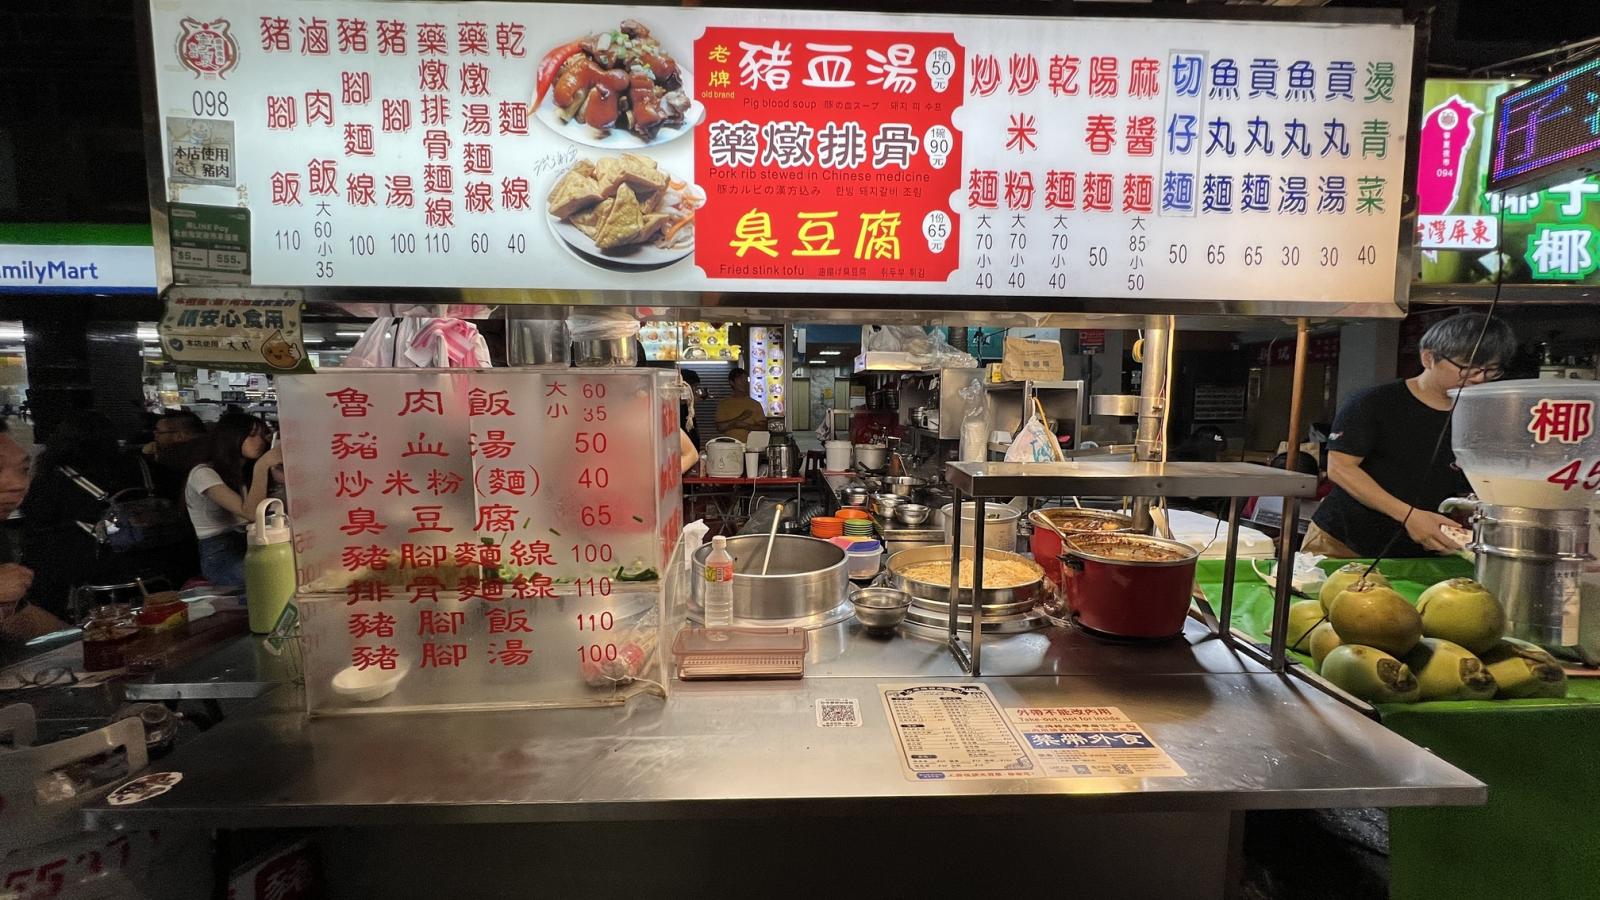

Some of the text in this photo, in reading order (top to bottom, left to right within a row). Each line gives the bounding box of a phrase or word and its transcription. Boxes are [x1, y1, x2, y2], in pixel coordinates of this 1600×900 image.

[708, 44, 732, 88] 老牌
[931, 61, 951, 76] 50
[192, 90, 229, 117] 098
[701, 90, 735, 100] old brand
[743, 98, 817, 110] Pig blood soup
[260, 16, 302, 207] 豬腳飯
[299, 16, 339, 197] 滷肉飯
[337, 18, 377, 206] 豬腳麵線
[376, 19, 416, 208] 豬腳湯
[496, 22, 531, 211] 乾麵線
[416, 22, 454, 228] 藥燉排骨麵線
[457, 21, 496, 214] 藥燉湯麵線
[968, 53, 1001, 210] 炒麵
[1004, 53, 1040, 210] 炒米粉
[1045, 54, 1080, 212] 乾麵
[1082, 56, 1119, 213] 陽春麵
[1122, 57, 1160, 214] 麻醬麵
[1162, 55, 1202, 211] 切仔麵
[1202, 58, 1240, 214] 魚丸麵
[1240, 58, 1279, 213] 貢丸麵
[1278, 60, 1316, 215] 魚丸湯
[1317, 61, 1356, 215] 貢丸湯
[1356, 61, 1396, 215] 燙青菜
[174, 146, 229, 162] 本店使用
[710, 121, 919, 169] 藥燉排骨
[930, 139, 949, 154] 90
[202, 164, 229, 178] 豬肉
[709, 168, 930, 182] Pork rib stewed in Chinese medicine
[1436, 169, 1453, 178] 094
[315, 201, 331, 217] 大
[314, 221, 332, 239] 60
[927, 223, 947, 238] 65
[978, 214, 991, 228] 大
[1012, 213, 1026, 228] 大
[1054, 214, 1068, 228] 大
[1131, 216, 1145, 230] 大
[275, 229, 301, 251] 110
[391, 233, 416, 254] 100
[425, 233, 450, 254] 110
[471, 233, 489, 254] 60
[508, 234, 526, 254] 40
[729, 208, 902, 260] 臭豆腐
[976, 234, 993, 250] 70
[1010, 233, 1027, 250] 70
[1052, 233, 1068, 250] 70
[1129, 235, 1146, 252] 85
[317, 242, 333, 257] 小
[349, 235, 375, 256] 100
[1169, 244, 1187, 264] 50
[1207, 244, 1226, 265] 65
[1358, 245, 1376, 265] 40
[1532, 229, 1592, 273] 椰
[977, 254, 991, 268] 小
[1010, 253, 1025, 268] 小
[1051, 254, 1066, 268] 小
[1089, 246, 1108, 267] 50
[1129, 255, 1144, 270] 小
[1244, 246, 1263, 266] 65
[1282, 246, 1300, 266] 30
[1320, 246, 1339, 267] 30
[0, 261, 98, 284] milyMart
[316, 261, 334, 278] 35
[719, 264, 805, 276] Fried stink tofu
[976, 272, 993, 289] 40
[1008, 272, 1025, 288] 40
[1049, 272, 1066, 289] 40
[1127, 274, 1145, 291] 50
[545, 381, 567, 398] 大
[583, 383, 606, 399] 60
[326, 387, 516, 418] 魯肉飯
[546, 403, 568, 419] 小
[583, 405, 607, 422] 35
[1530, 400, 1592, 443] 椰
[575, 432, 607, 453] 50
[577, 467, 609, 489] 40
[340, 503, 519, 536] 臭豆腐
[581, 505, 612, 527] 65
[341, 540, 558, 571] 豬腳麵線
[571, 543, 612, 563] 100
[347, 573, 560, 605] 排骨麵線
[574, 577, 611, 597] 110
[348, 608, 534, 638] 豬腳飯
[577, 611, 613, 631] 110
[352, 640, 533, 671] 豬腳湯
[577, 643, 617, 663] 100
